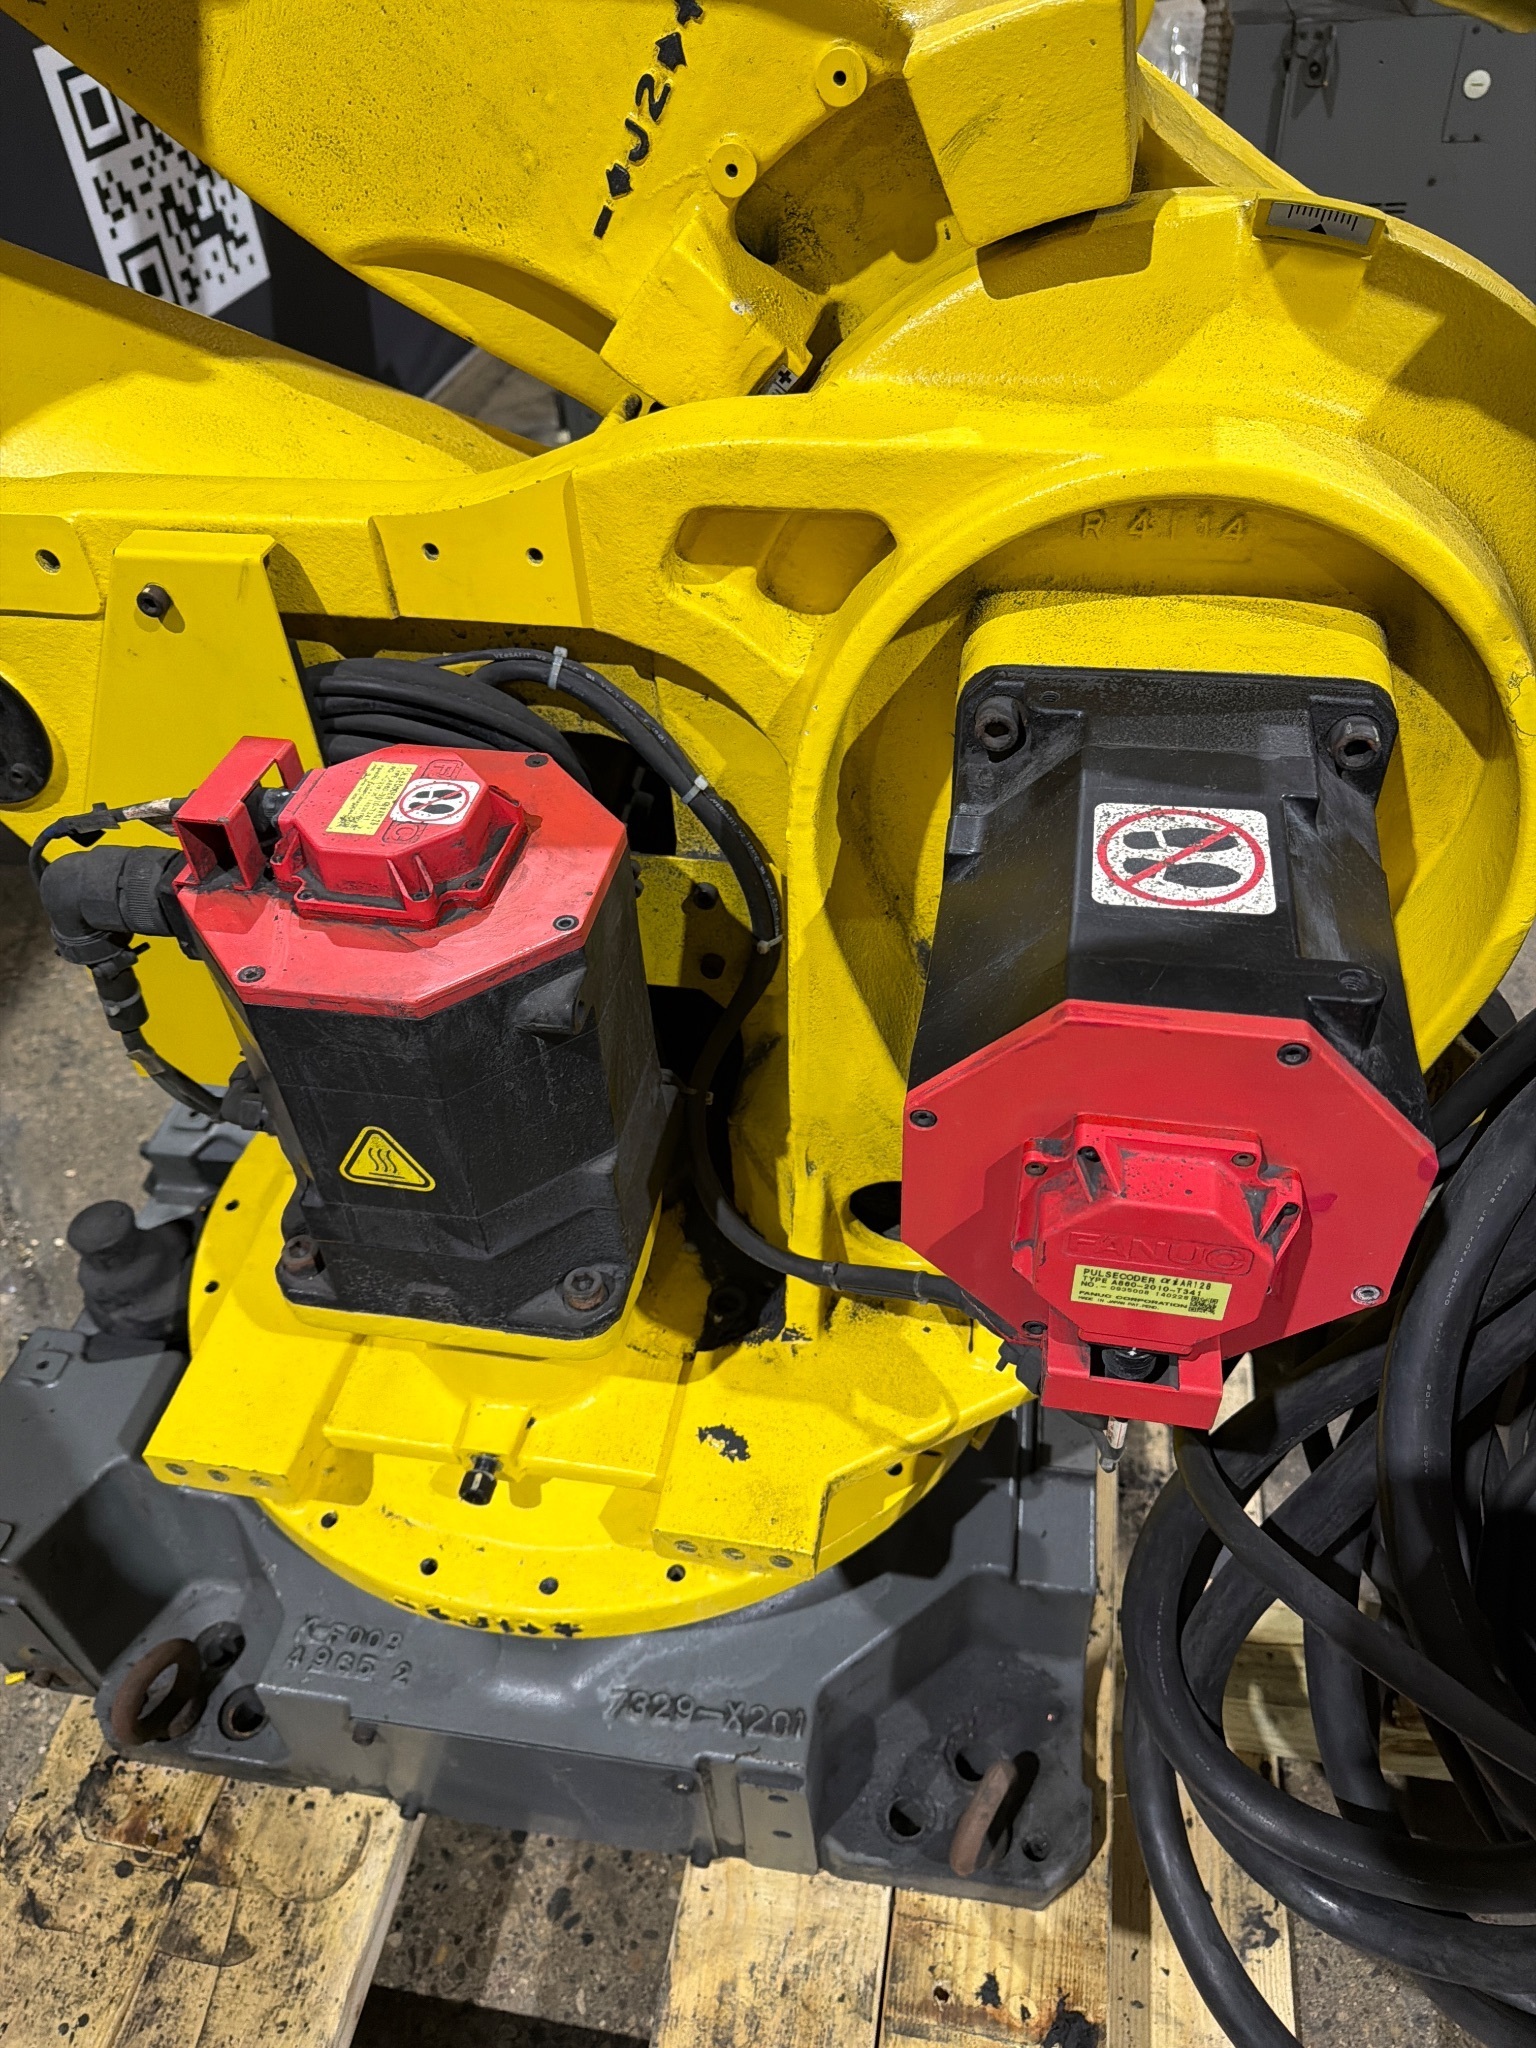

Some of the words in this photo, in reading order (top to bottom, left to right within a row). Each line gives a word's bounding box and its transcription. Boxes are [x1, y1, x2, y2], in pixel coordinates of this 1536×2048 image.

[624, 73, 671, 163] J2
[1069, 1231, 1246, 1271] FANUC
[1082, 1275, 1108, 1284] TYPE
[1084, 1268, 1156, 1284] PULSECODER
[1079, 1290, 1112, 1299] FANUC
[1115, 1295, 1188, 1309] CORPORATION
[603, 1685, 808, 1742] 7329-X201
